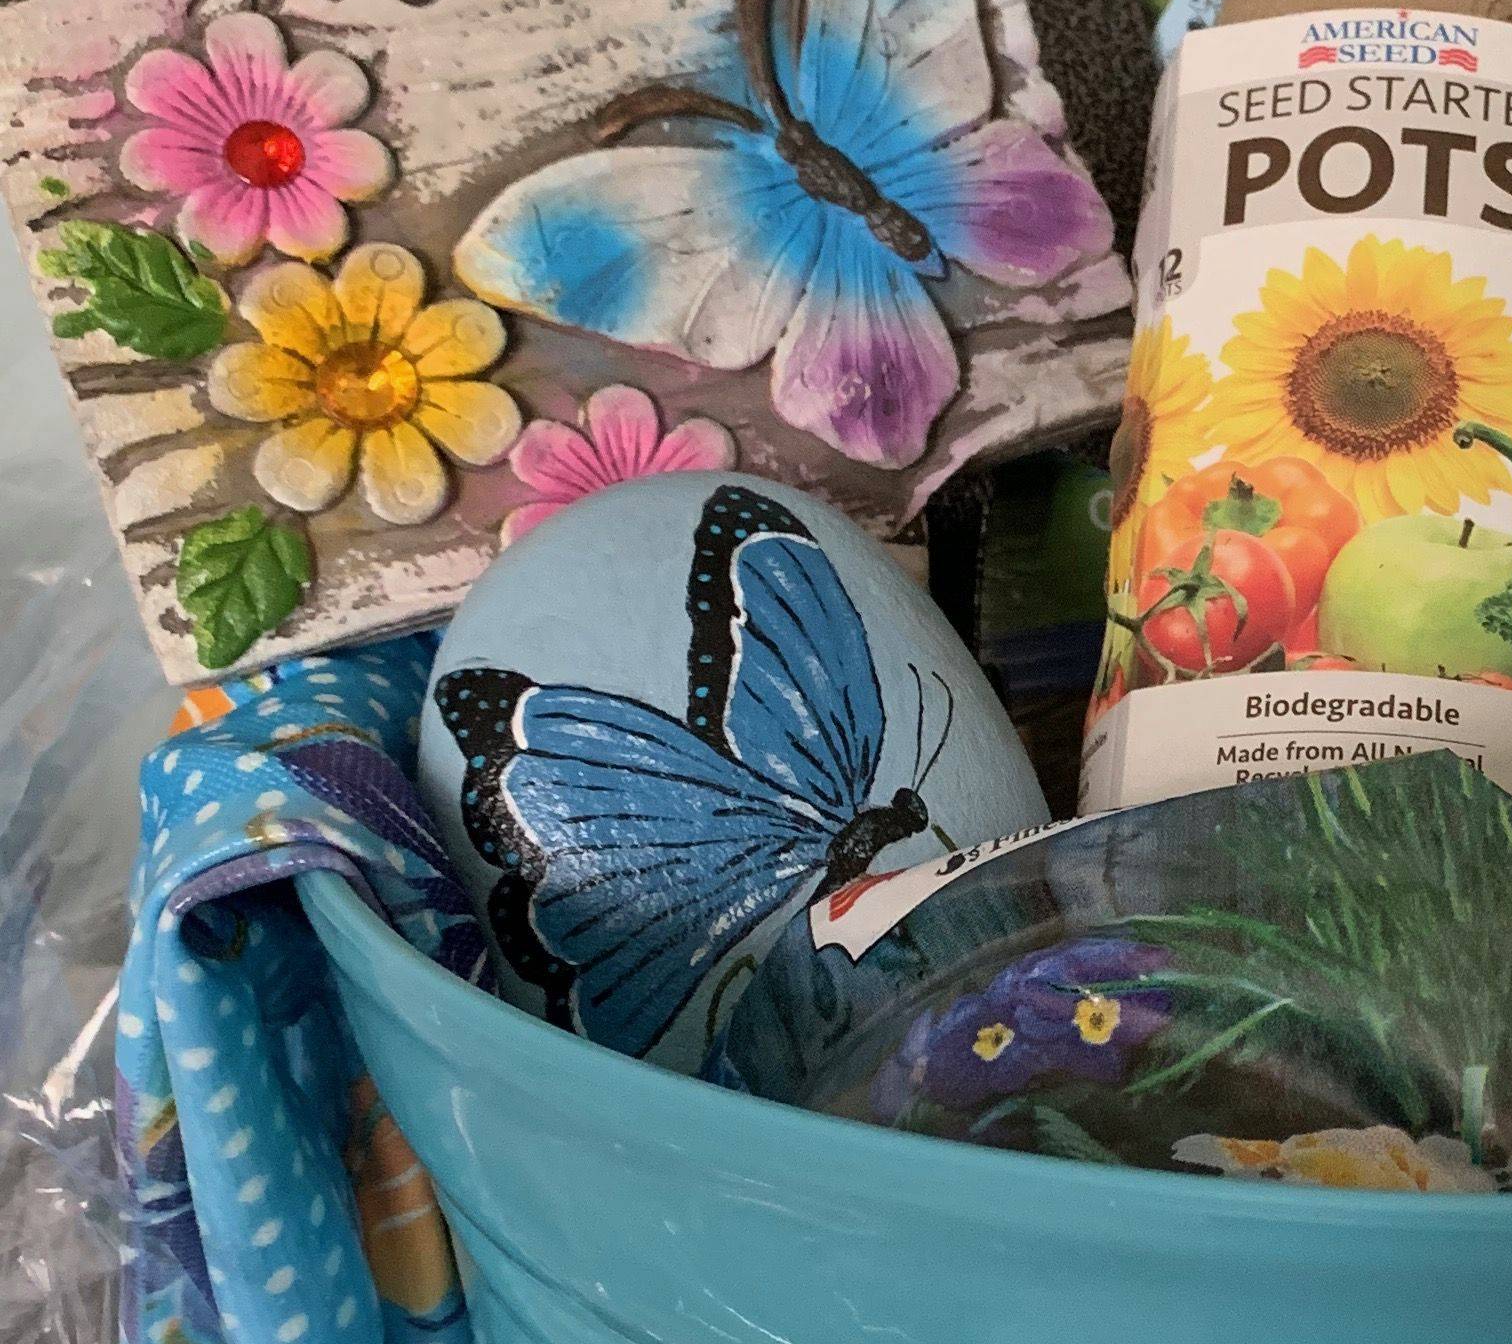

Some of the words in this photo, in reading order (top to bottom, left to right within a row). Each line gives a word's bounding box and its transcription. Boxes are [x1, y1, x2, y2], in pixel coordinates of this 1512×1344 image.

[1301, 19, 1479, 47] AMERICAN
[1337, 43, 1438, 65] SEED
[1217, 78, 1332, 128] SEED
[1245, 692, 1460, 726] Biodegradable
[1216, 742, 1279, 766] Made
[1286, 740, 1343, 761] from
[1351, 741, 1385, 762] All
